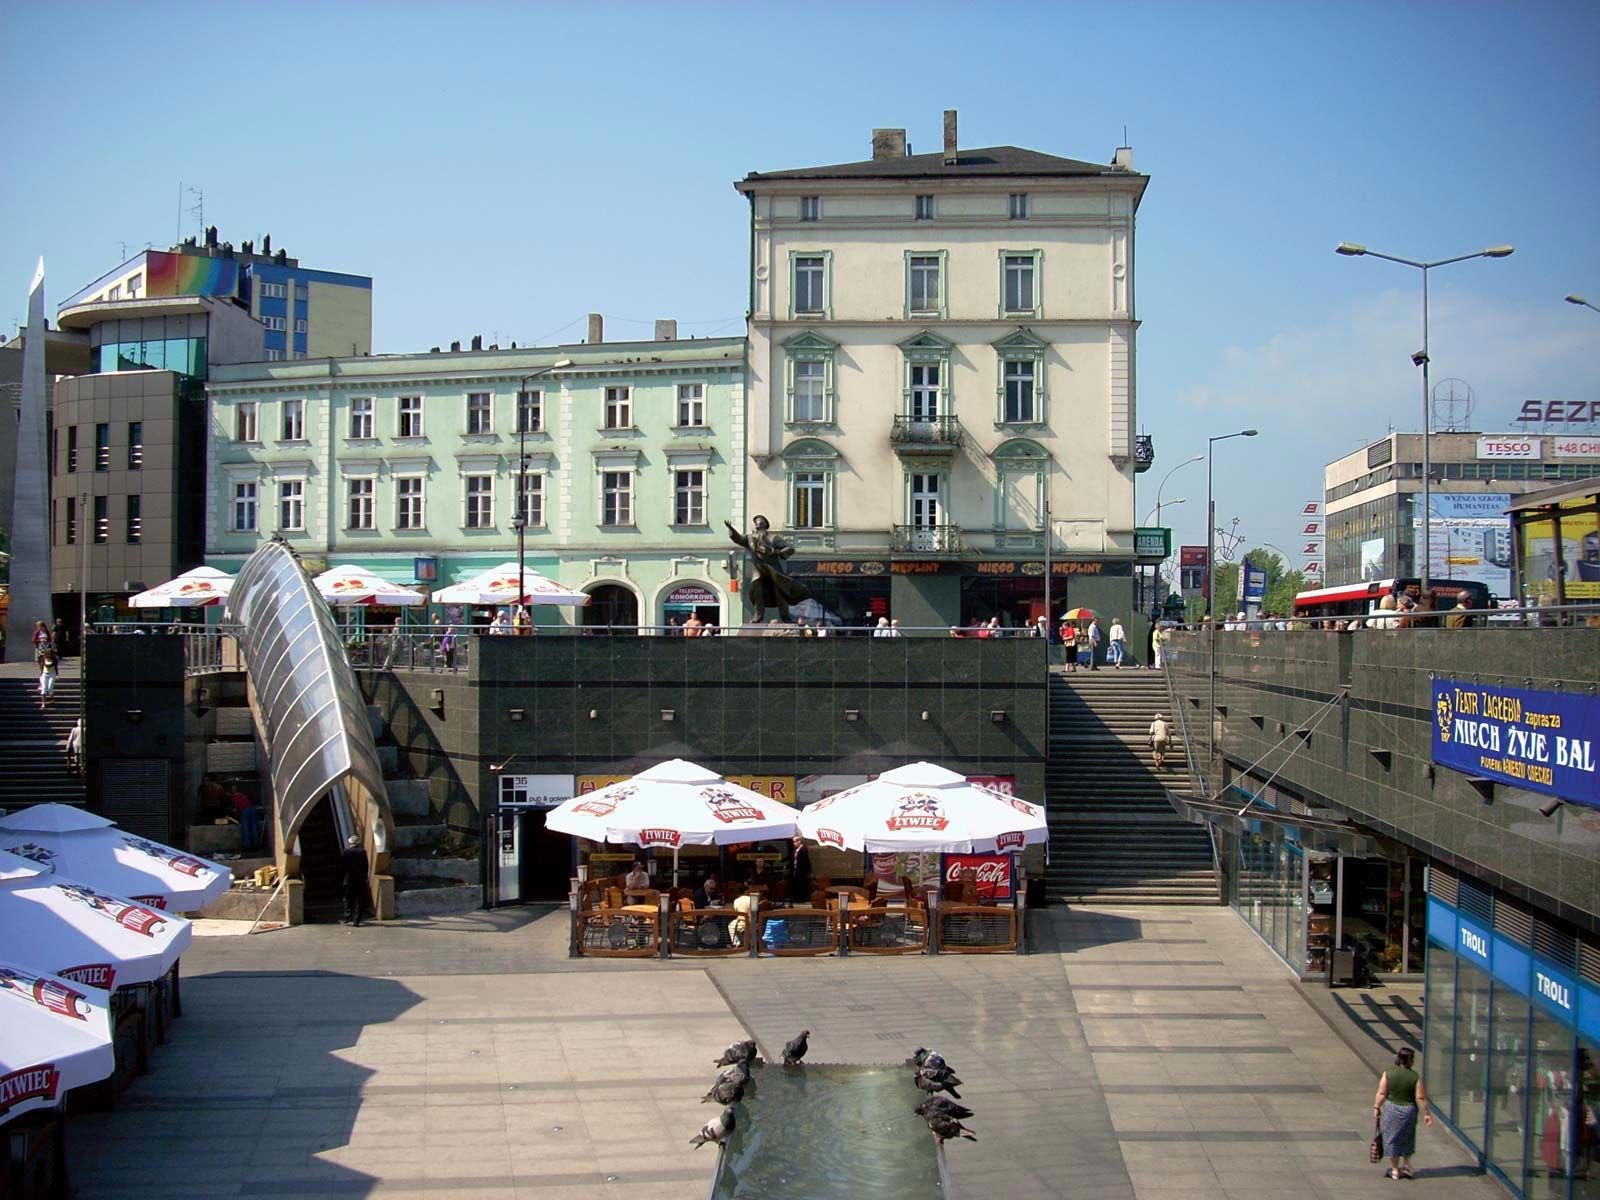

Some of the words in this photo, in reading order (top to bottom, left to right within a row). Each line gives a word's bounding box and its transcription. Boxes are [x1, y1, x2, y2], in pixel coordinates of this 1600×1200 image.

[1486, 443, 1531, 452] TESCO
[816, 562, 854, 575] MIĘSO
[978, 562, 1016, 575] MIĘSO
[1455, 688, 1478, 715] TEATR
[1482, 692, 1522, 724] ZAGŁĘBIA
[1525, 711, 1561, 730] zaprasza
[1454, 718, 1500, 751] NIECH
[1508, 725, 1549, 762] ŻYJE
[1556, 736, 1596, 772] BAL
[1461, 927, 1487, 958] TROLL
[1536, 972, 1570, 1009] TROLL
